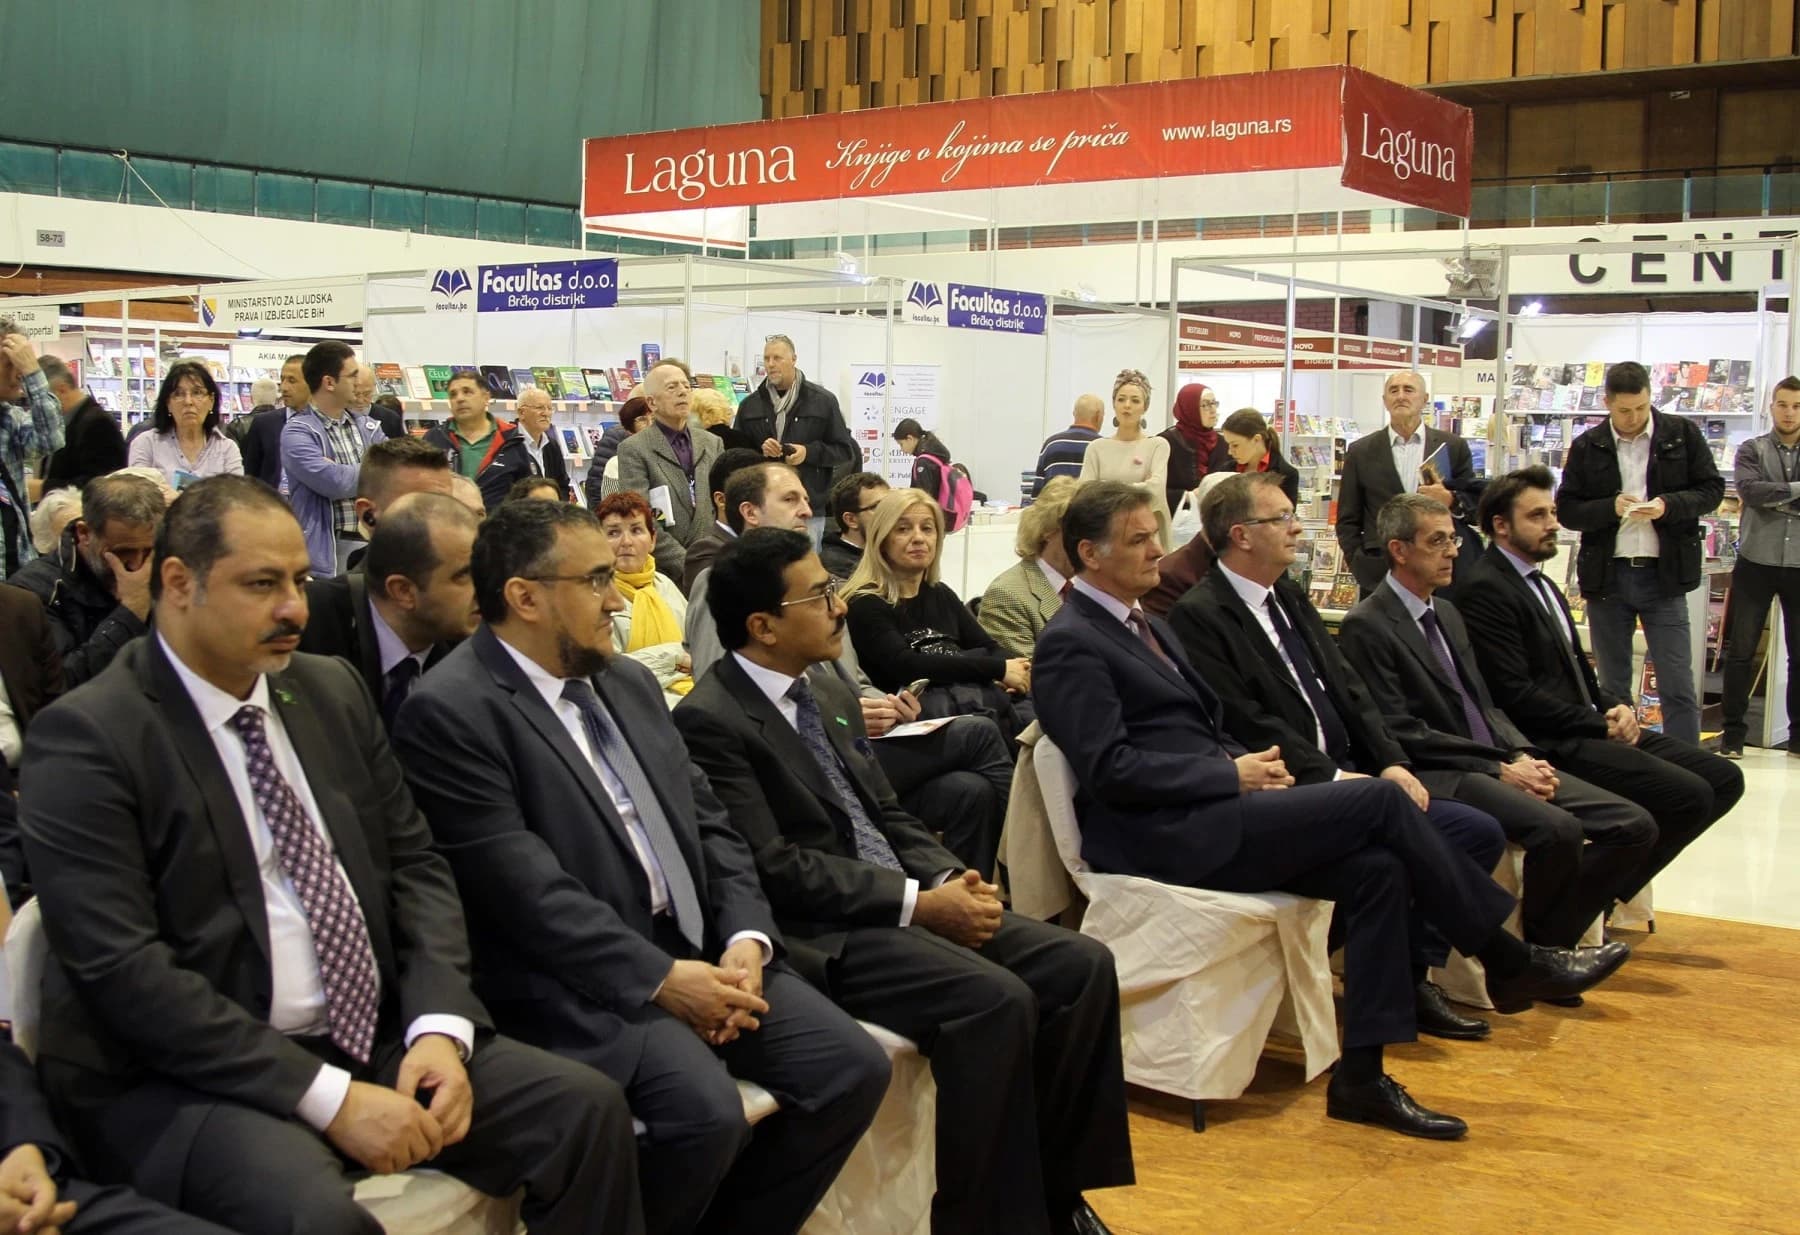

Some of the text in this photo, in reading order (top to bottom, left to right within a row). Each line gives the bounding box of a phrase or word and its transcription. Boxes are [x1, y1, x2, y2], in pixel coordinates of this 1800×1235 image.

[1361, 113, 1456, 182] Laguna
[624, 117, 1292, 201] Laguna Knjige o kojima se priča www.laguna.rs
[482, 268, 614, 293] Facultas d.o.o.
[228, 293, 333, 308] MINISTARSTVO ZA LJUDSKA
[508, 293, 586, 308] Brčko distrikt
[951, 288, 1044, 318] Facultas d.o.o.
[17, 311, 35, 321] Tuzla
[235, 311, 259, 321] PRAVA
[265, 309, 309, 320] IZBJEGLICE
[311, 308, 325, 318] BiH
[971, 314, 1025, 330] Brčko distrikt
